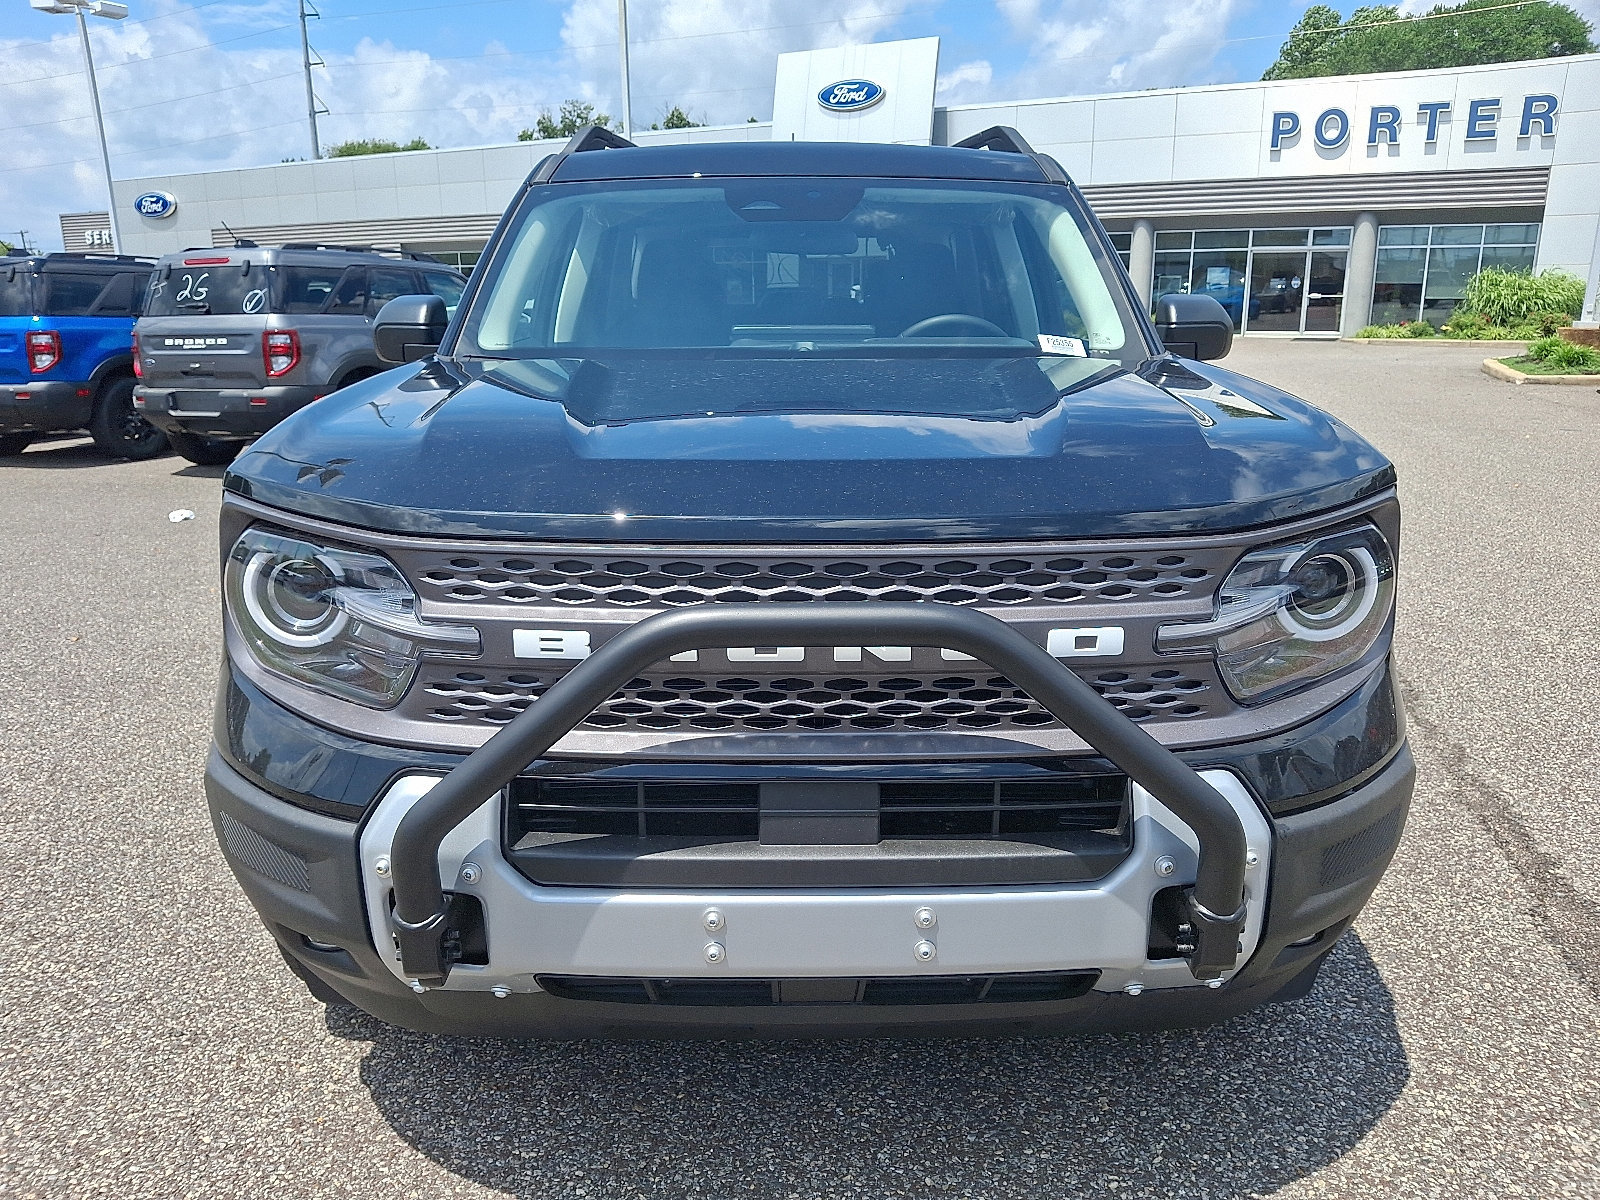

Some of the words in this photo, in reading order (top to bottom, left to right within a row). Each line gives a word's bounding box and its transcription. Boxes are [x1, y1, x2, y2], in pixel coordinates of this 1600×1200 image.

[829, 83, 869, 104] Ford
[1269, 93, 1559, 152] PORTER
[141, 196, 164, 213] Ford
[164, 338, 228, 346] BRONCO
